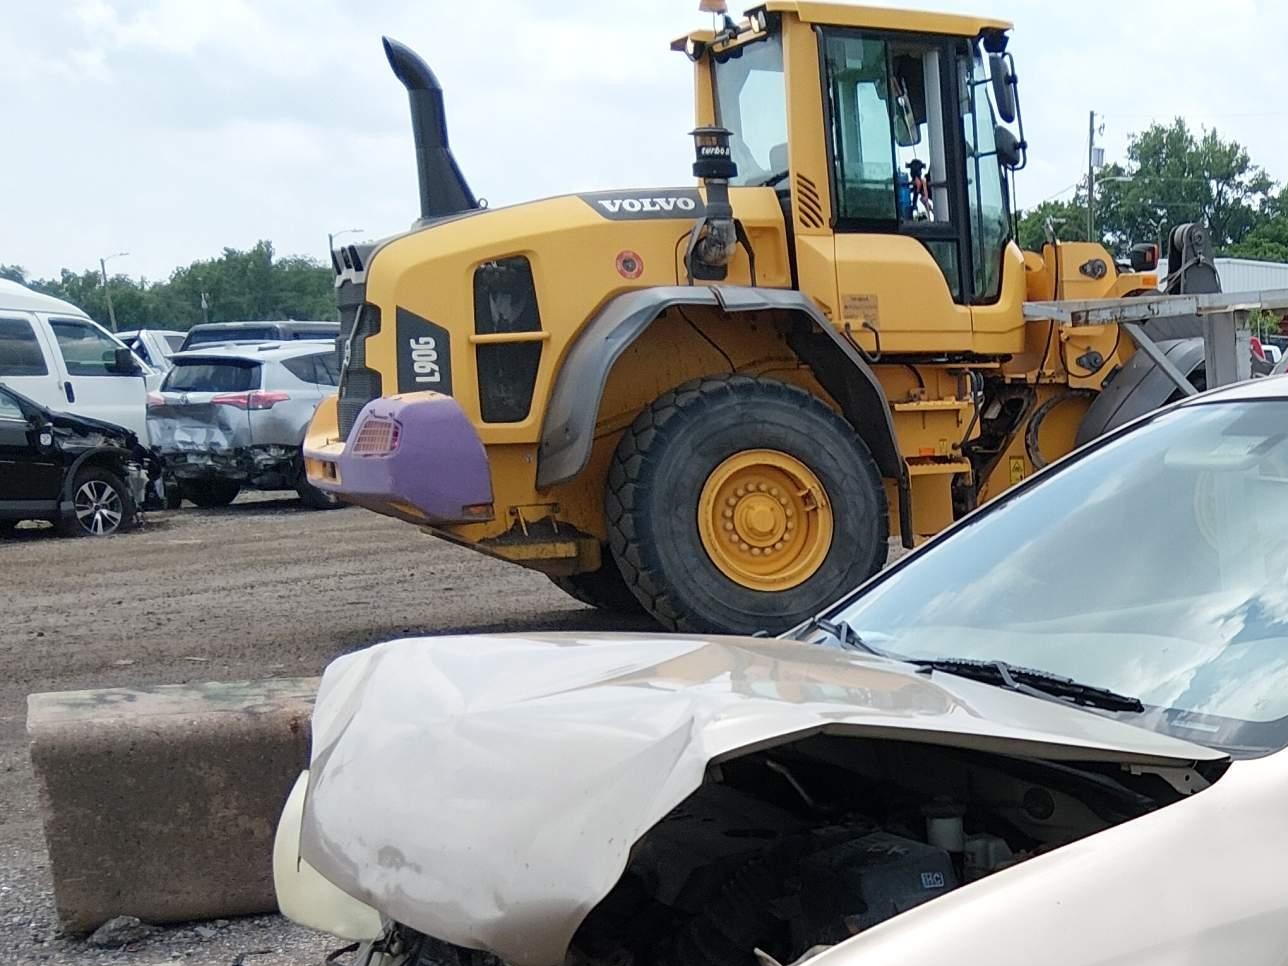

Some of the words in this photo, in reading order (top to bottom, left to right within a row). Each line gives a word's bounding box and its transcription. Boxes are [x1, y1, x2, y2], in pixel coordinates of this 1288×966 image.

[701, 146, 725, 156] turbo
[599, 197, 696, 213] VOLVO
[409, 336, 441, 383] L90G
